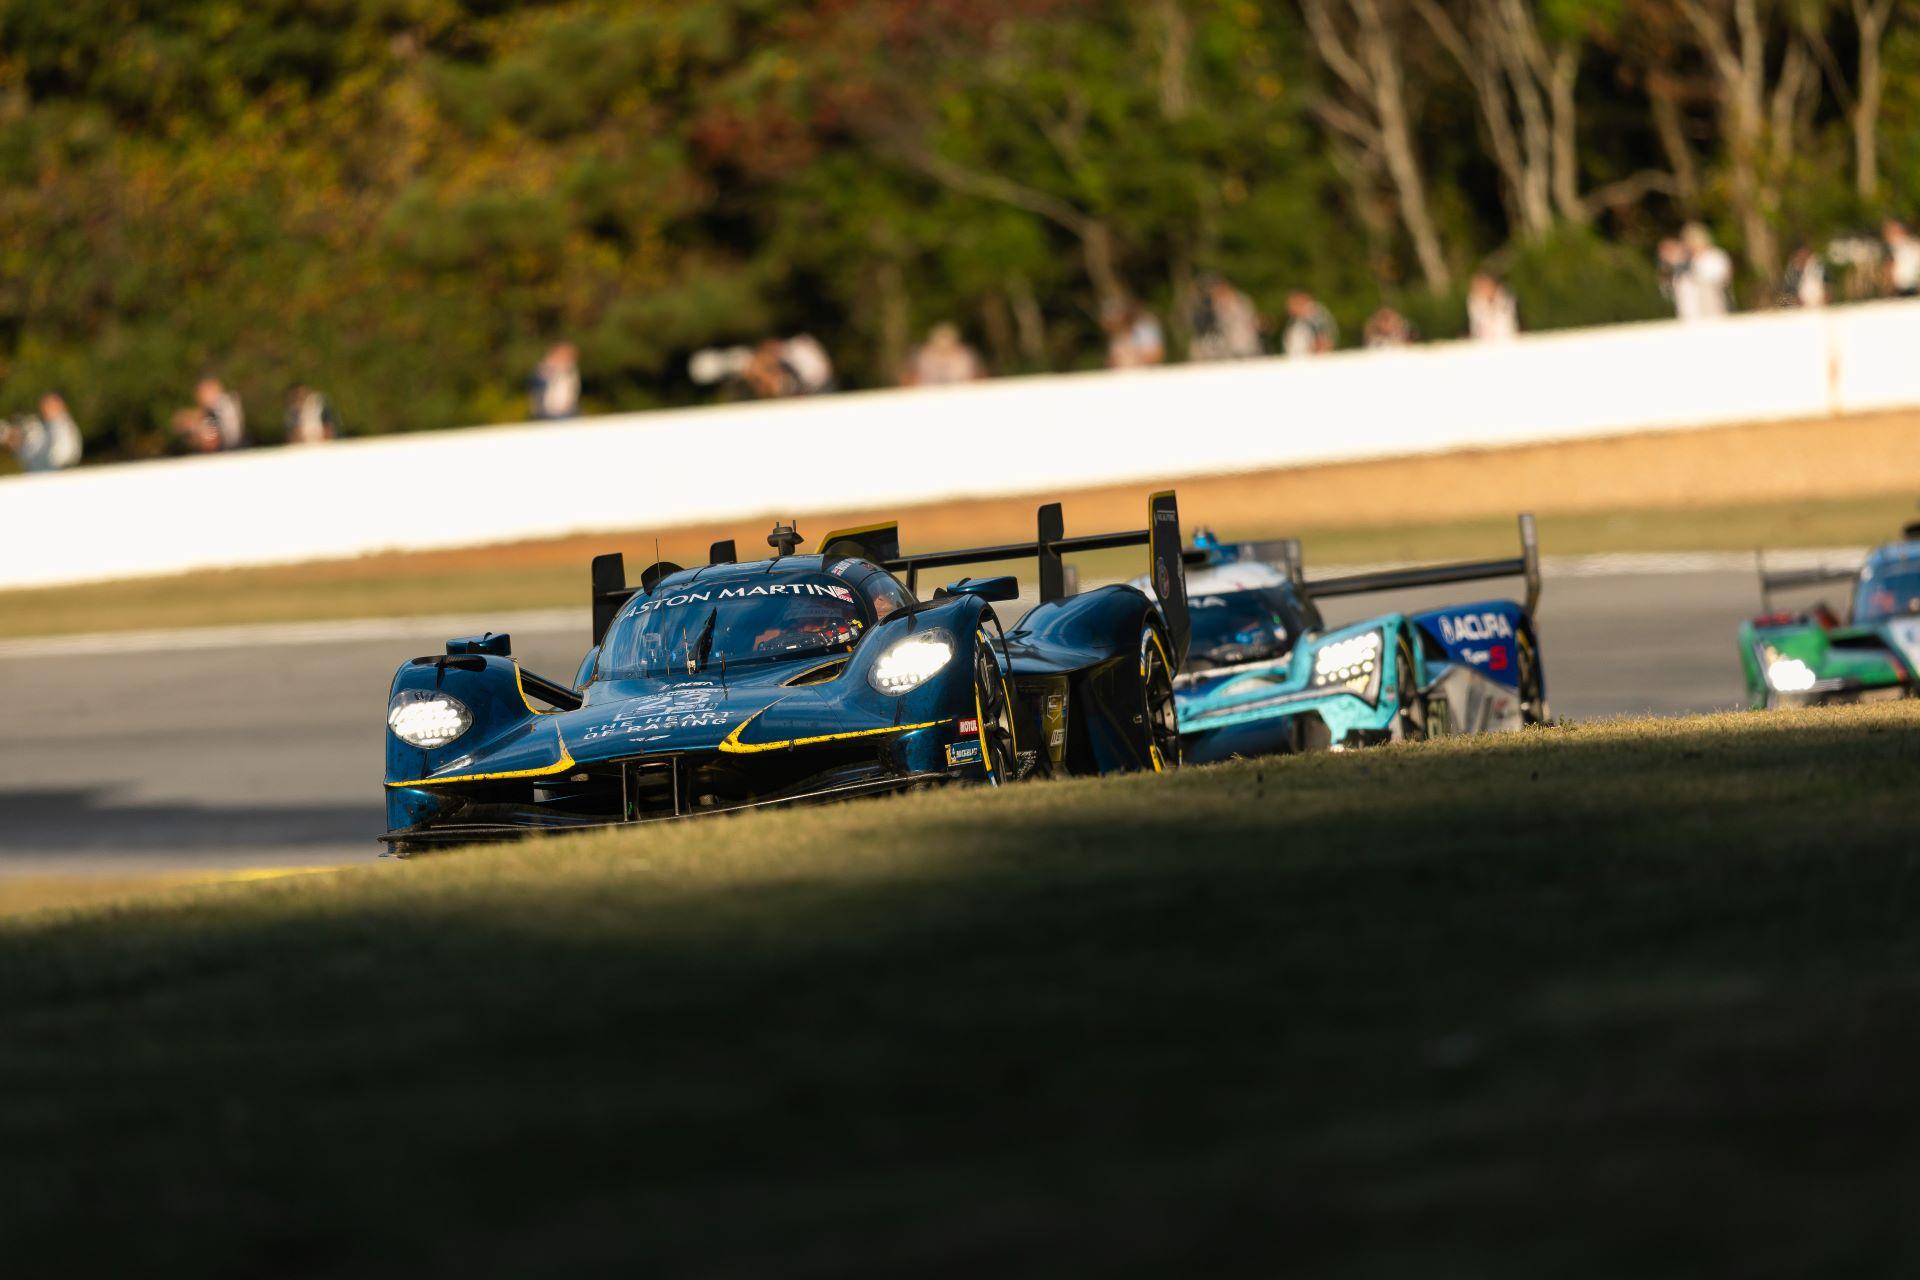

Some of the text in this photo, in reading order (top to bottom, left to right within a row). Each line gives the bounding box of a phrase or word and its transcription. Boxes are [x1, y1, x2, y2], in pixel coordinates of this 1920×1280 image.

[619, 584, 841, 622] ASTON MARTIN
[1454, 613, 1512, 641] ACURA
[583, 718, 727, 740] OF RACING
[586, 720, 634, 733] THE
[646, 711, 735, 724] HEART
[960, 719, 978, 733] MOTUL
